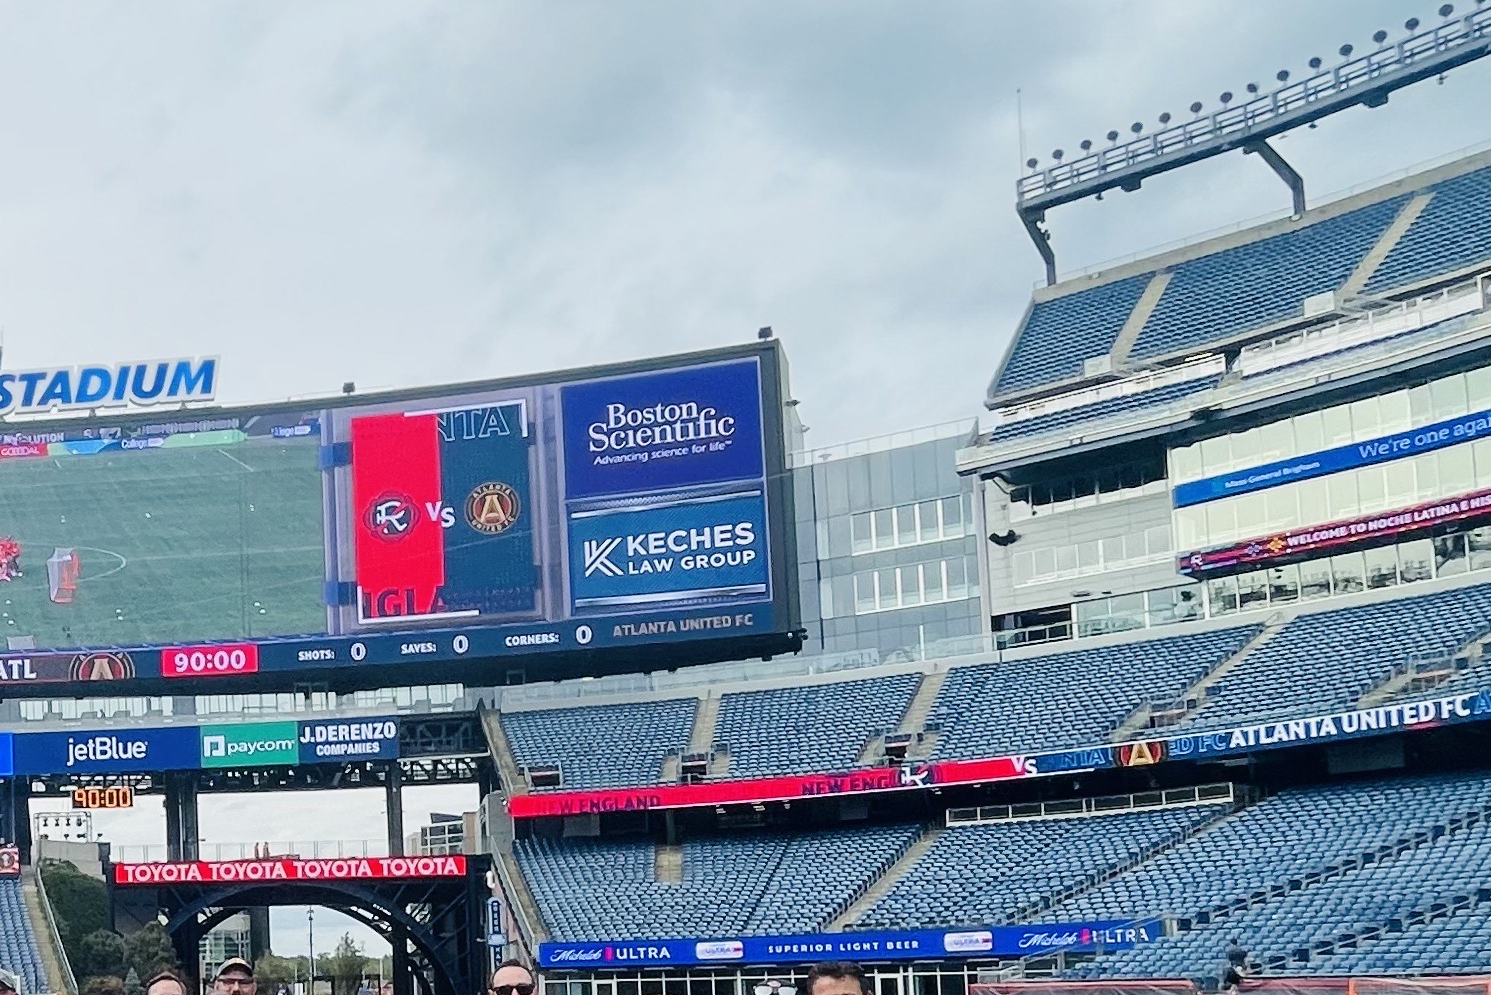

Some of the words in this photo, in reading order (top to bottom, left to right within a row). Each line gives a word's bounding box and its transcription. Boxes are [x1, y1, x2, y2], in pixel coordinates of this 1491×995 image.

[607, 401, 698, 428] Boston
[588, 407, 736, 454] Scientific
[593, 452, 648, 467] Advancing
[650, 446, 687, 460] science
[690, 443, 706, 456] for
[1359, 438, 1411, 459] We're
[1415, 428, 1450, 447] one
[1286, 527, 1349, 547] WELCOME
[1349, 522, 1365, 535] TO
[1413, 502, 1460, 524] LATINA
[627, 521, 756, 557] KECHES
[628, 558, 673, 576] LAW
[679, 549, 756, 571] GROUP
[505, 632, 560, 647] CORNERS:
[576, 626, 593, 646] 0
[612, 619, 677, 638] ATLANTA
[679, 615, 732, 633] UNITED
[736, 614, 754, 628] FC
[298, 648, 335, 662] SHOTS:
[350, 642, 366, 662] 0
[401, 642, 437, 656] SAVES:
[453, 634, 469, 655] 0
[173, 650, 247, 672] 90:00
[299, 720, 397, 743] J.DERENZO
[1229, 717, 1338, 749] ATLANTA
[1341, 702, 1436, 733] UNITED
[1440, 695, 1472, 719] FC
[66, 737, 146, 766] jetBlue
[227, 740, 293, 757] paycom
[316, 740, 381, 757] COMPANIES
[75, 787, 132, 808] 90:00
[578, 796, 661, 813] ENGLAND
[124, 863, 202, 883] TOYOTA
[208, 860, 286, 881] TOYOTA
[293, 858, 372, 879] TOYOTA
[379, 856, 459, 877] TOYOTA
[616, 946, 671, 960] ULTRA
[768, 943, 833, 954] SUPERIOR
[839, 941, 880, 951] LIGHT
[886, 940, 920, 950] BEER
